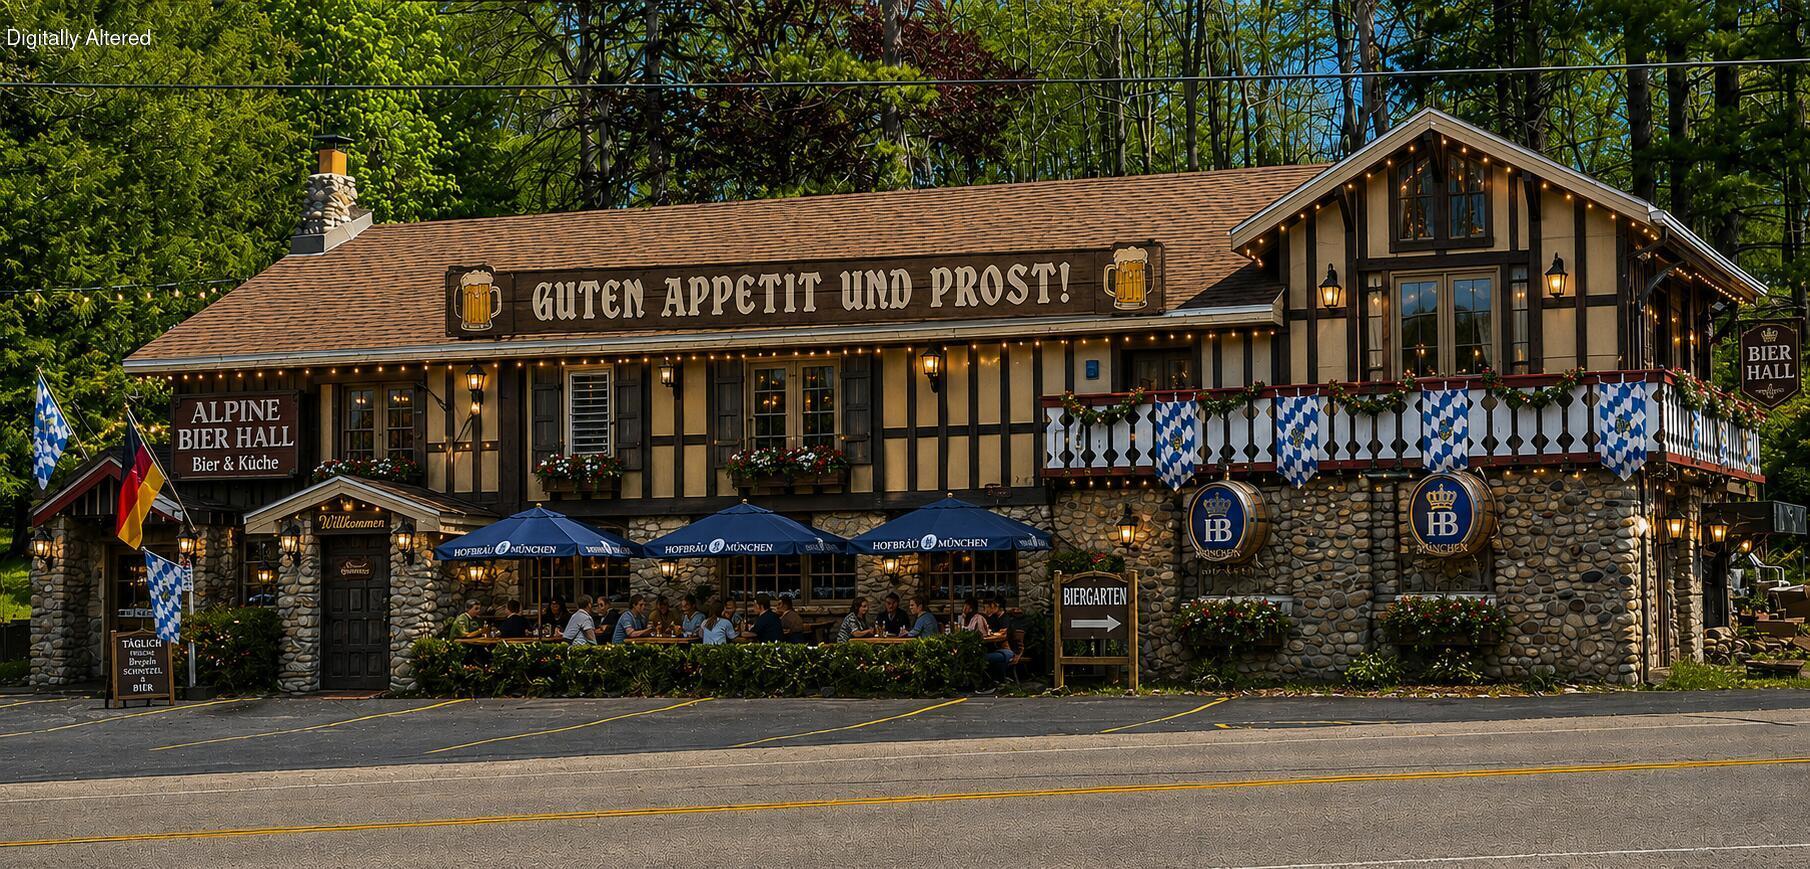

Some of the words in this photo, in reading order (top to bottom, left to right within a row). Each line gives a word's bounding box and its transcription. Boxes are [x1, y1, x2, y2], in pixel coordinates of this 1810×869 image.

[531, 277, 645, 321] GUTEN
[661, 271, 823, 318] APPETIT
[839, 267, 913, 311] UND
[929, 260, 1071, 308] PROST!
[1747, 344, 1792, 361] BIER
[1746, 363, 1795, 380] HALL
[191, 399, 281, 424] ALPINE
[177, 428, 230, 450] BIER
[236, 425, 294, 448] HALL
[192, 456, 220, 472] Bier
[223, 455, 234, 471] &
[239, 454, 279, 471] Küche
[319, 514, 385, 529] Willkommen
[1204, 518, 1232, 542] HB
[1426, 511, 1459, 536] HB
[454, 544, 495, 557] HOFBRÄU
[510, 543, 557, 554] MÜNCHEN
[665, 542, 708, 554] HOFBRÄU
[725, 541, 773, 552] MÜNCHEN
[873, 538, 919, 550] HOFBRÄU
[938, 537, 988, 548] MÜNCHEN
[1063, 587, 1127, 606] BIERGARTEN
[121, 638, 162, 648] TÄGLICH
[133, 683, 154, 692] BIER
